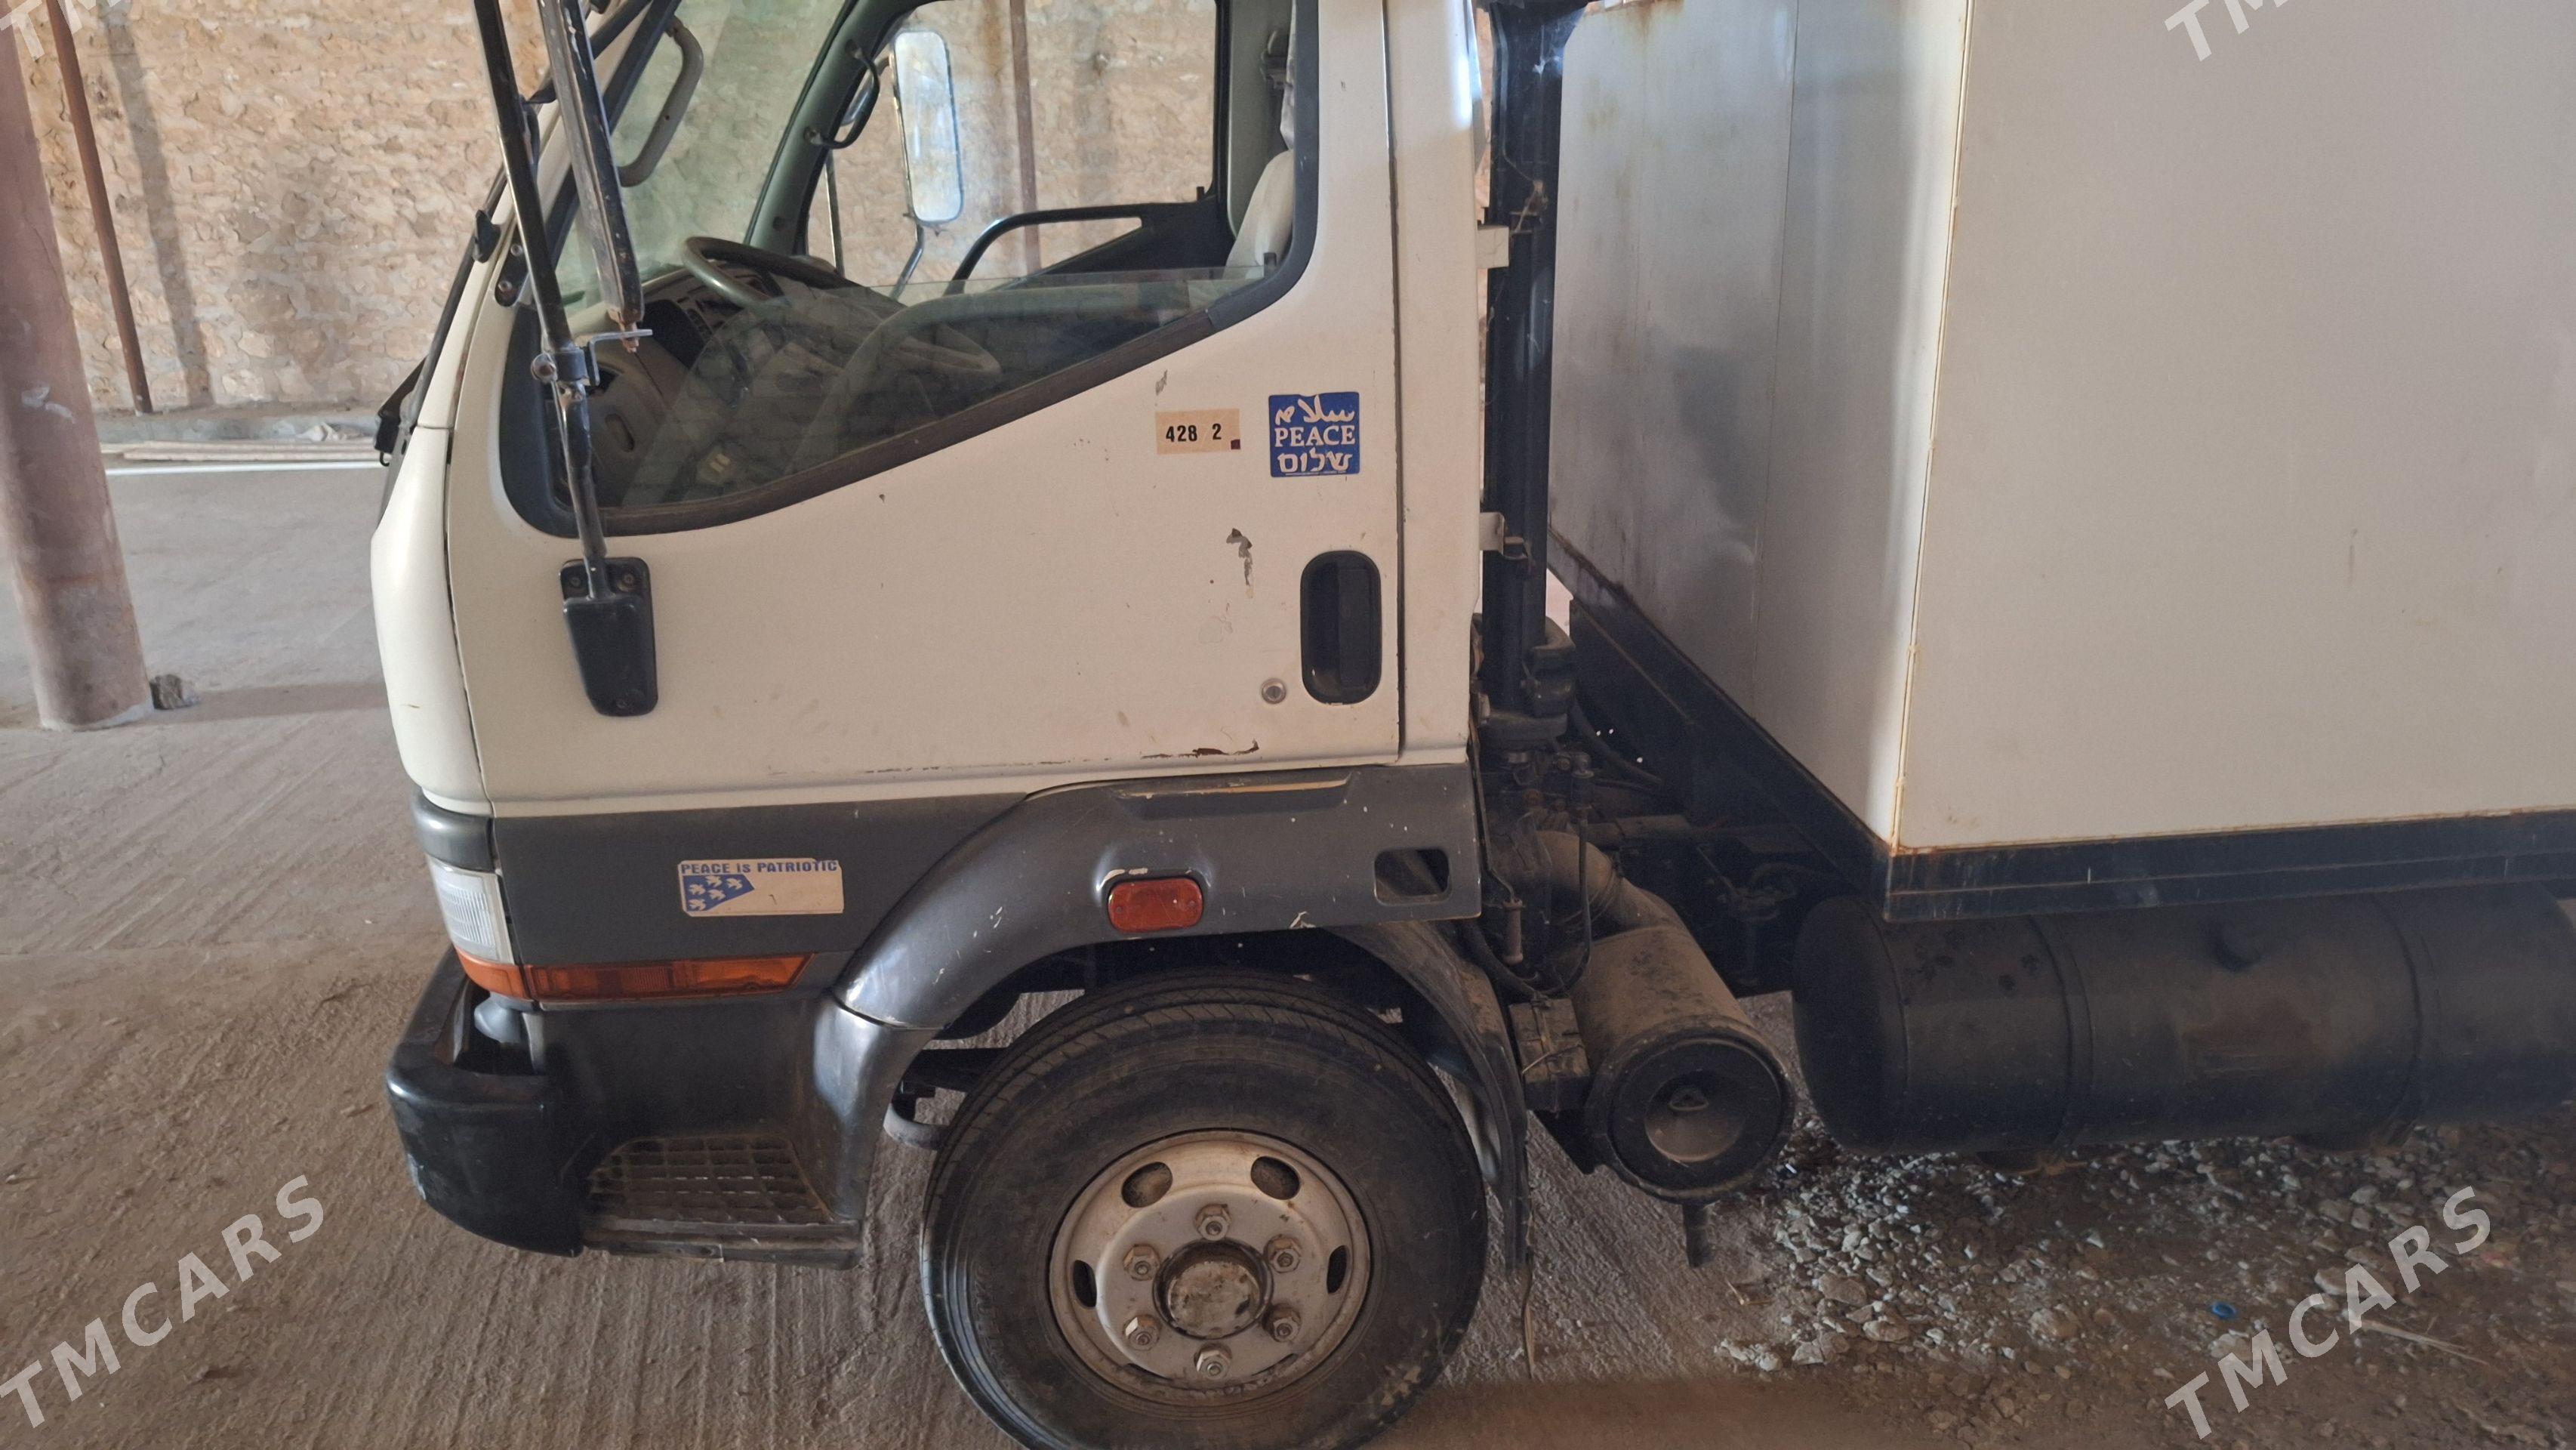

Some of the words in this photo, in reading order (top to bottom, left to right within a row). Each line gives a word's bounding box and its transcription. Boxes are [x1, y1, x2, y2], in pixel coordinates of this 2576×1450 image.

[1274, 394, 1355, 425] سلام
[1165, 424, 1198, 443] 428
[1212, 423, 1222, 440] 2
[1274, 424, 1356, 447] PEACE
[1277, 447, 1353, 473] שלום
[681, 862, 730, 874] PEACE
[757, 859, 838, 873] PATRIOTIC
